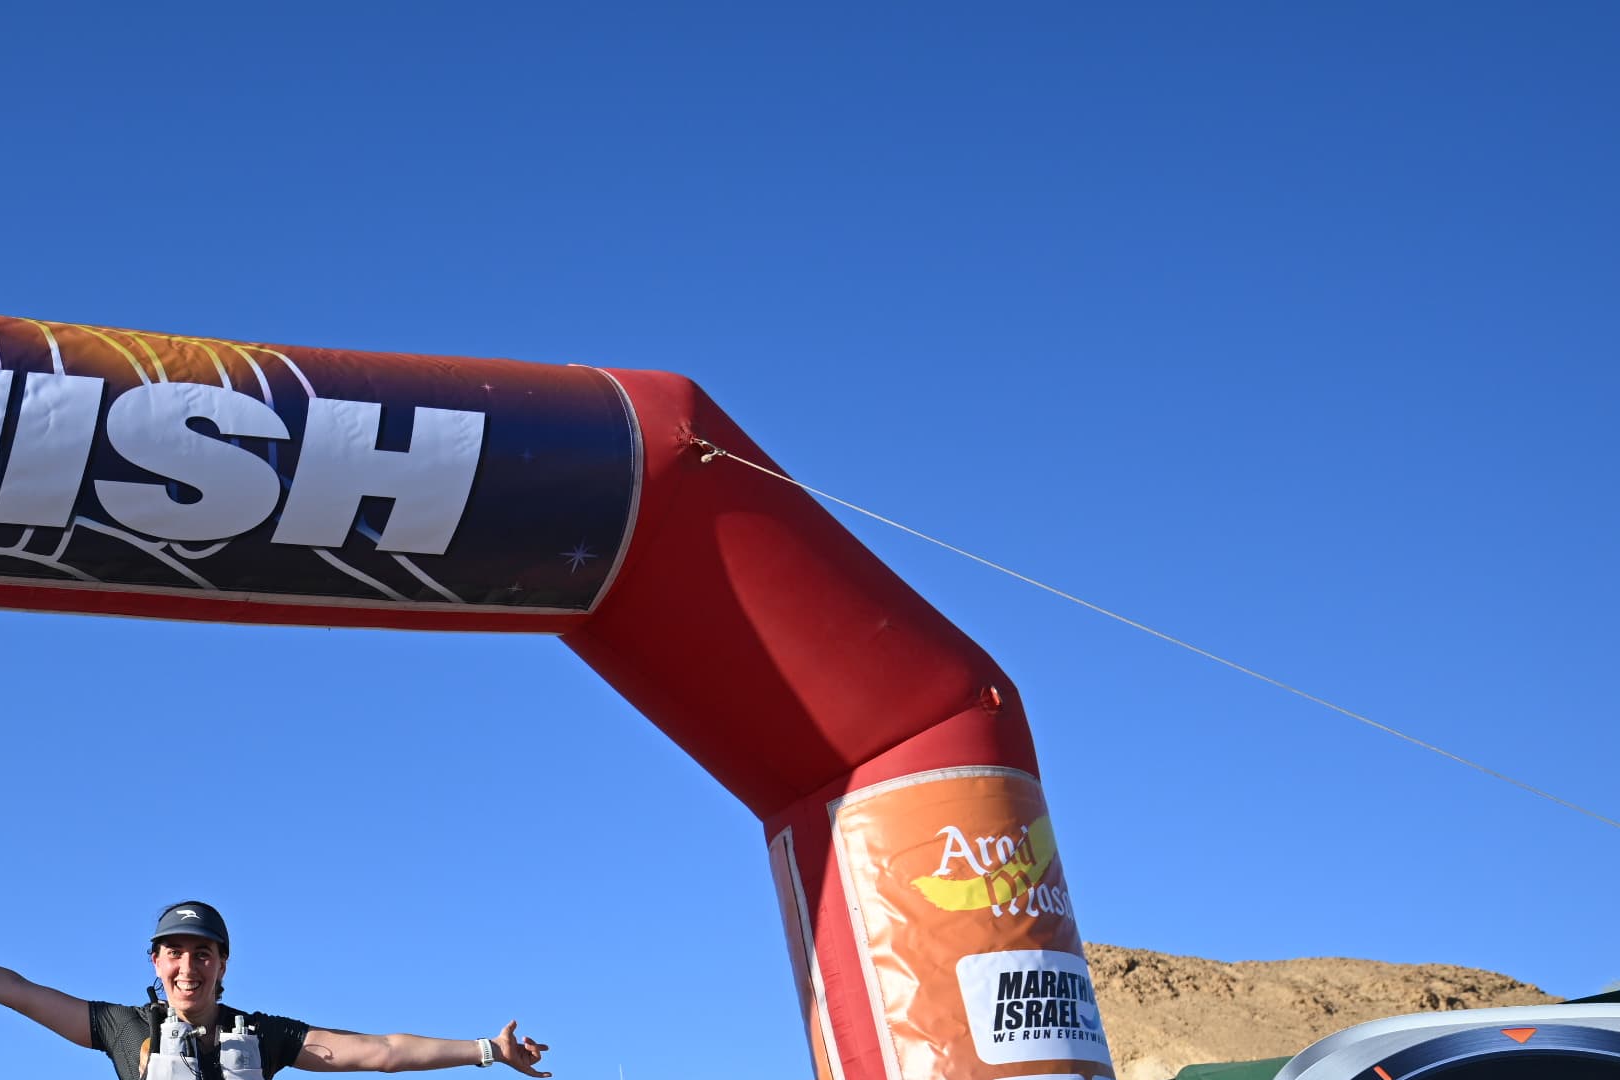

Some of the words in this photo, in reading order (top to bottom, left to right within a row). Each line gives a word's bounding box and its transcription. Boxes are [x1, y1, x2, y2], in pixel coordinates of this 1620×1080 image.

[932, 824, 1037, 876] Arad
[993, 999, 1080, 1032] ISRAEL
[993, 1032, 1016, 1044] WE
[1022, 1029, 1051, 1041] RUN
